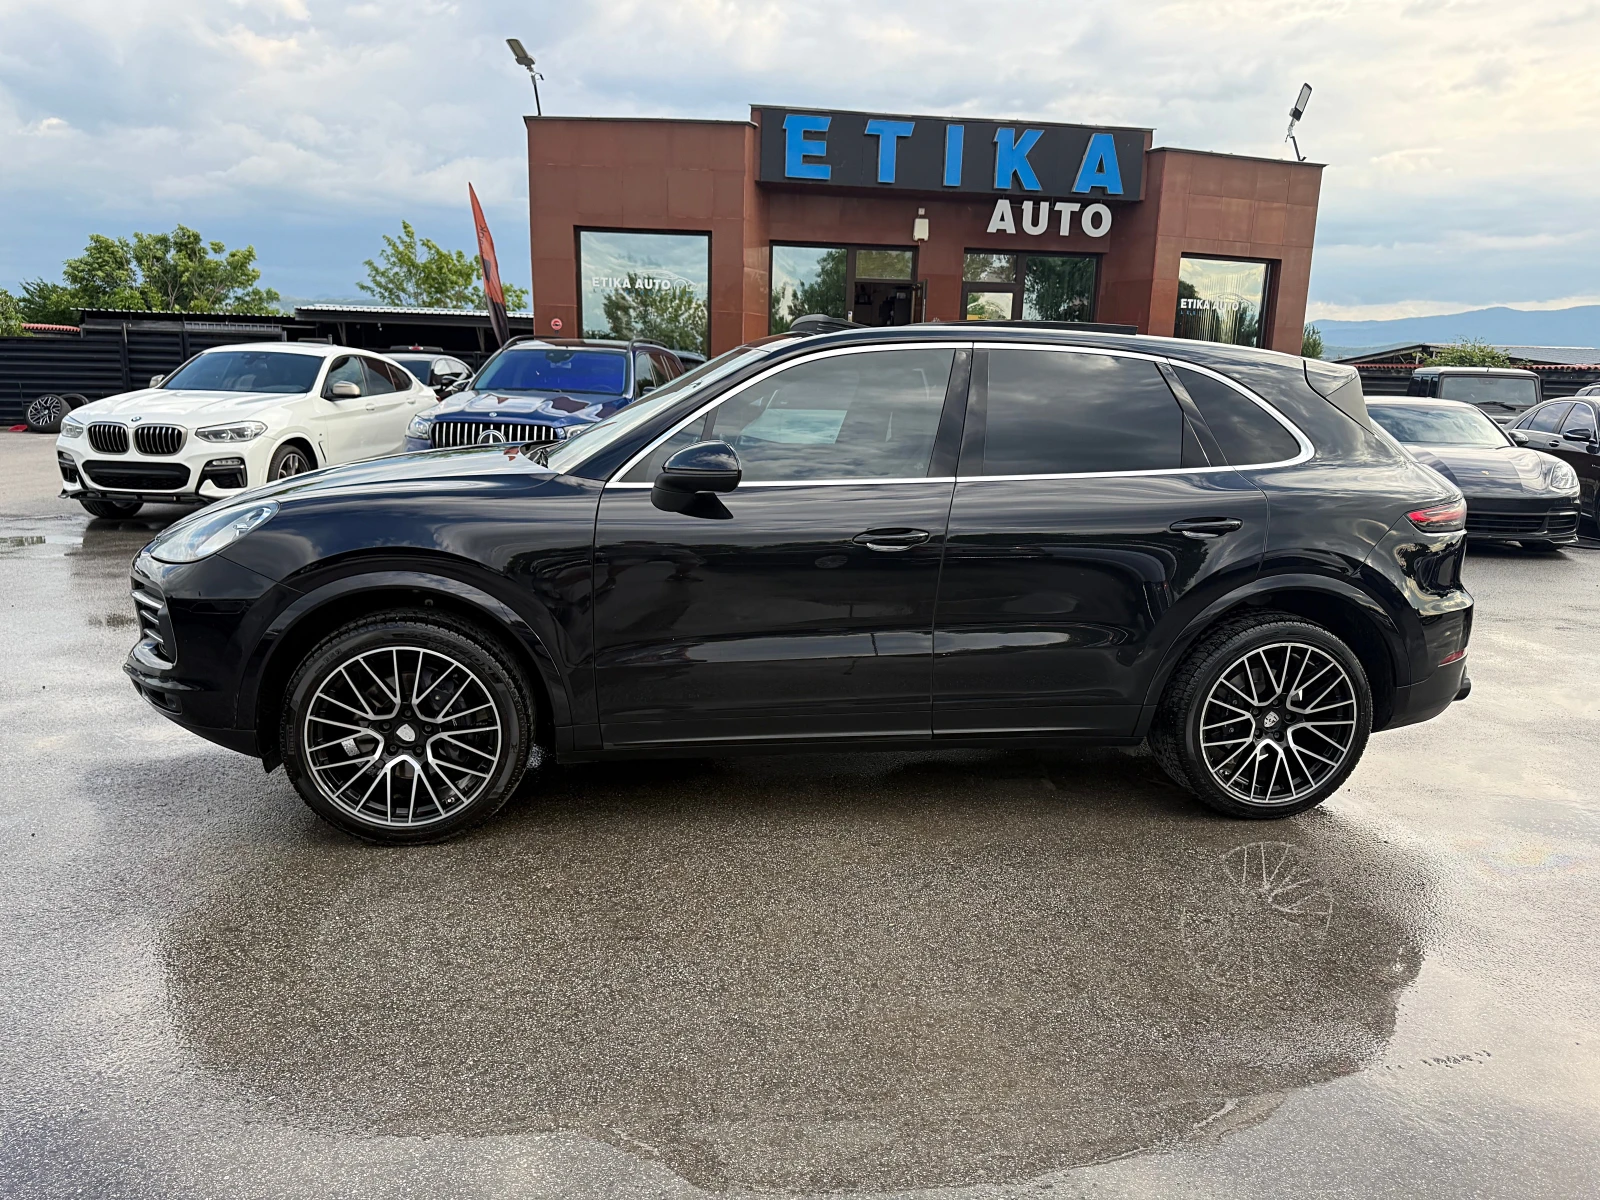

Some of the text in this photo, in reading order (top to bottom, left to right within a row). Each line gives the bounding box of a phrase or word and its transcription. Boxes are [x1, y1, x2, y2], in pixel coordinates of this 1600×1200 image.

[782, 114, 1124, 195] ETIKA
[986, 199, 1112, 238] AUTO
[592, 277, 671, 290] ETIKA AUTO
[1180, 298, 1239, 311] ETIKA AUTO
